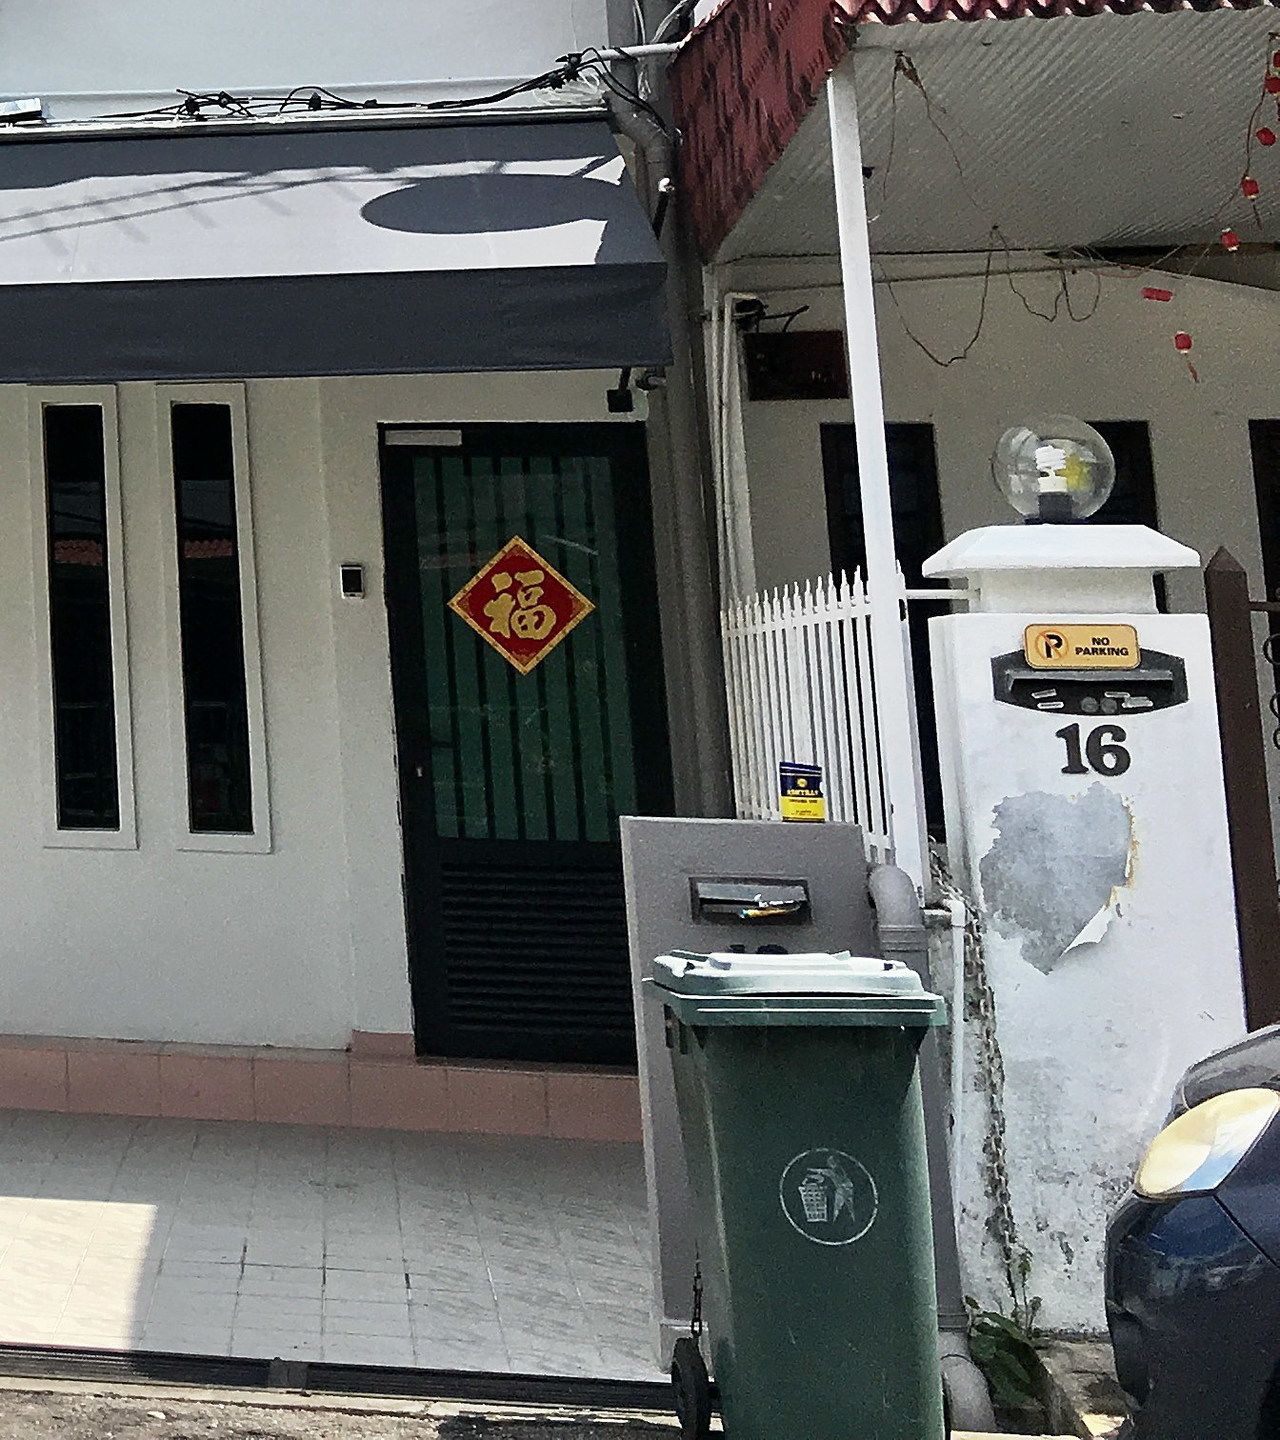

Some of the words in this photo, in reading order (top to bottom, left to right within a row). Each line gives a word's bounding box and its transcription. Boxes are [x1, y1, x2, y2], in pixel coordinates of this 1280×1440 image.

[483, 569, 557, 641] 福
[1075, 647, 1129, 657] PARKING
[1091, 637, 1110, 647] NO
[1055, 722, 1132, 777] 16
